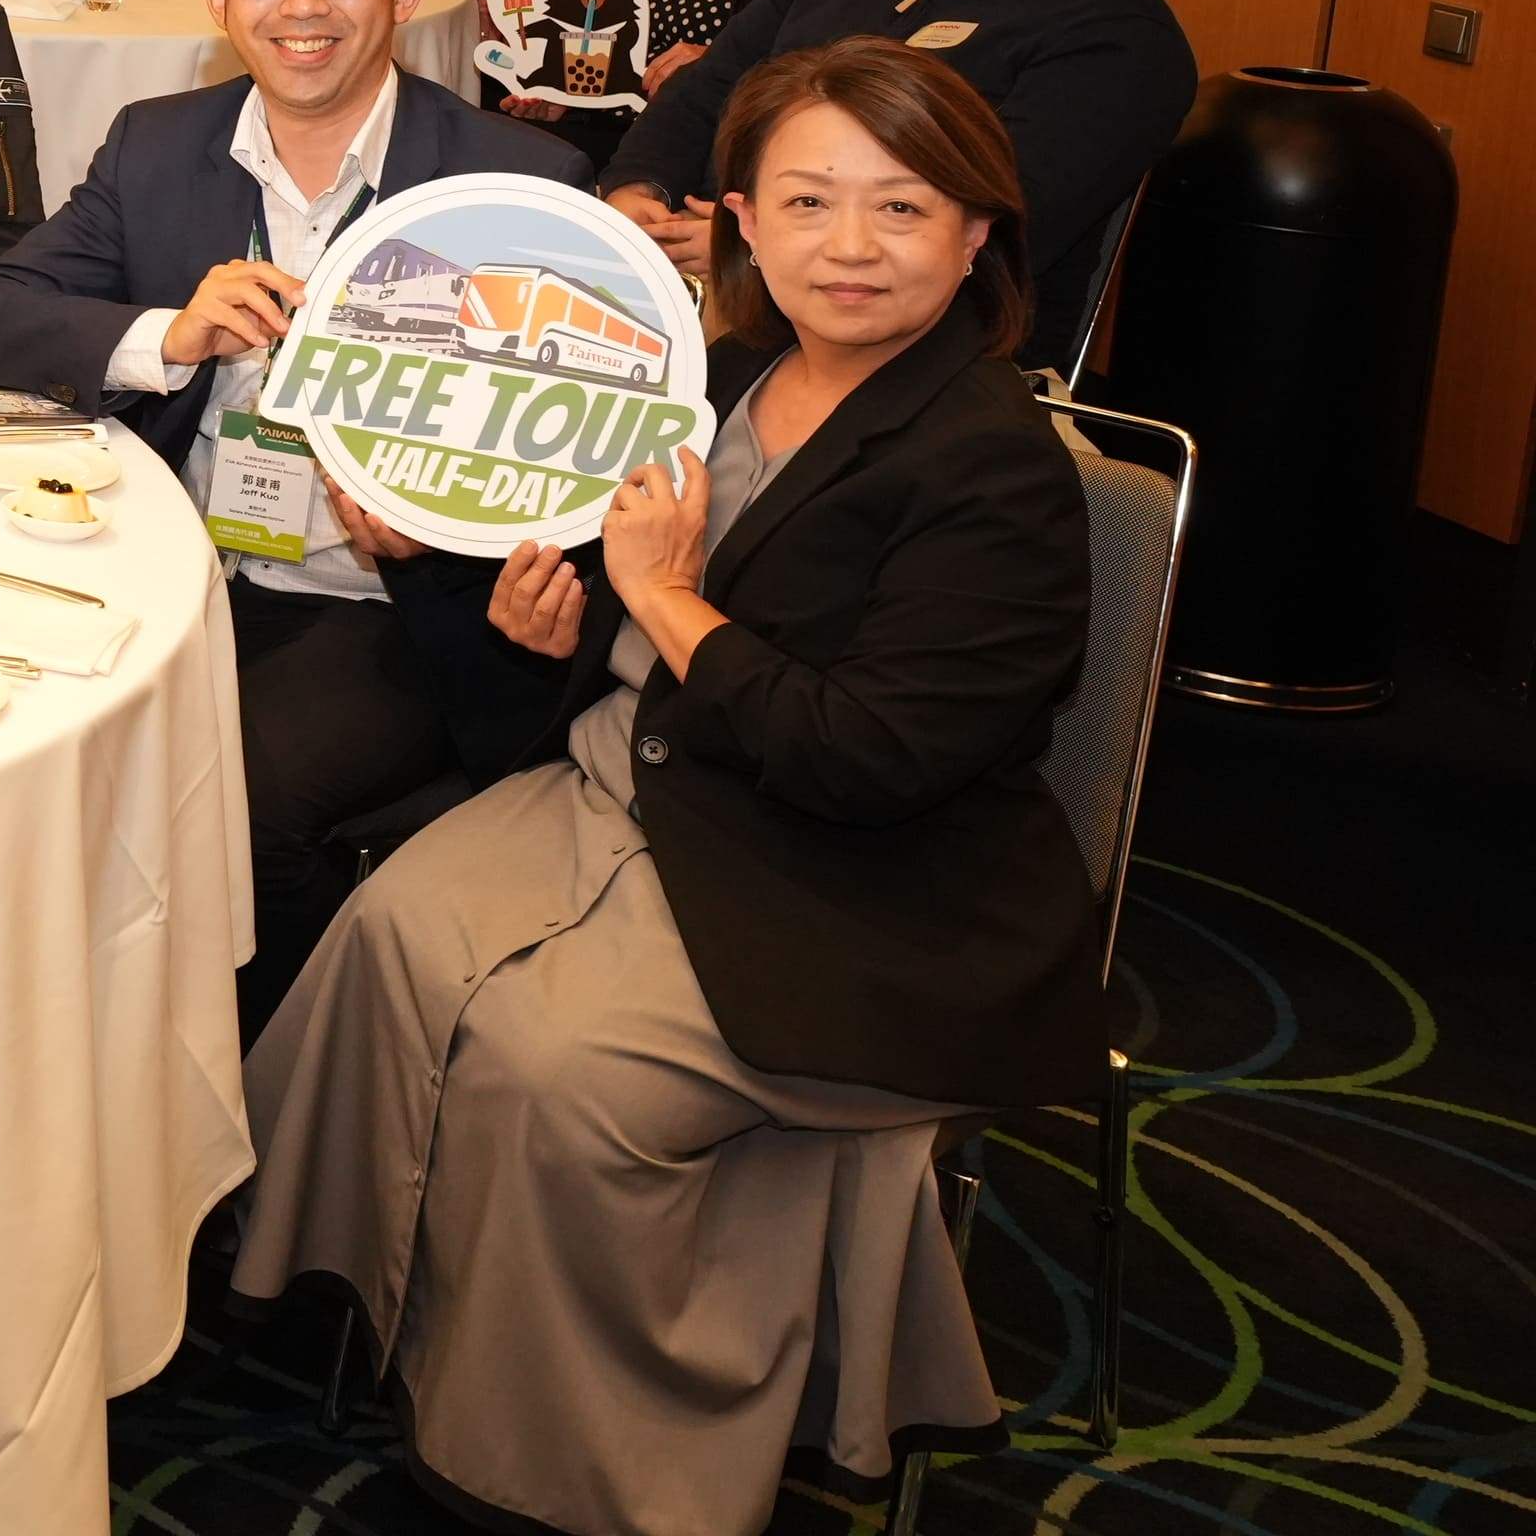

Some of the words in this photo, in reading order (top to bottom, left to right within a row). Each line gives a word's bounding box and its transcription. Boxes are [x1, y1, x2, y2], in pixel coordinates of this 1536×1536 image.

[568, 344, 624, 369] Taiwan
[272, 334, 469, 437] FREE
[474, 371, 697, 483] TOUR
[256, 426, 309, 444] TAIWAN
[370, 439, 578, 519] HALF-DAY
[240, 487, 257, 497] Jeff
[260, 490, 279, 502] Kuo
